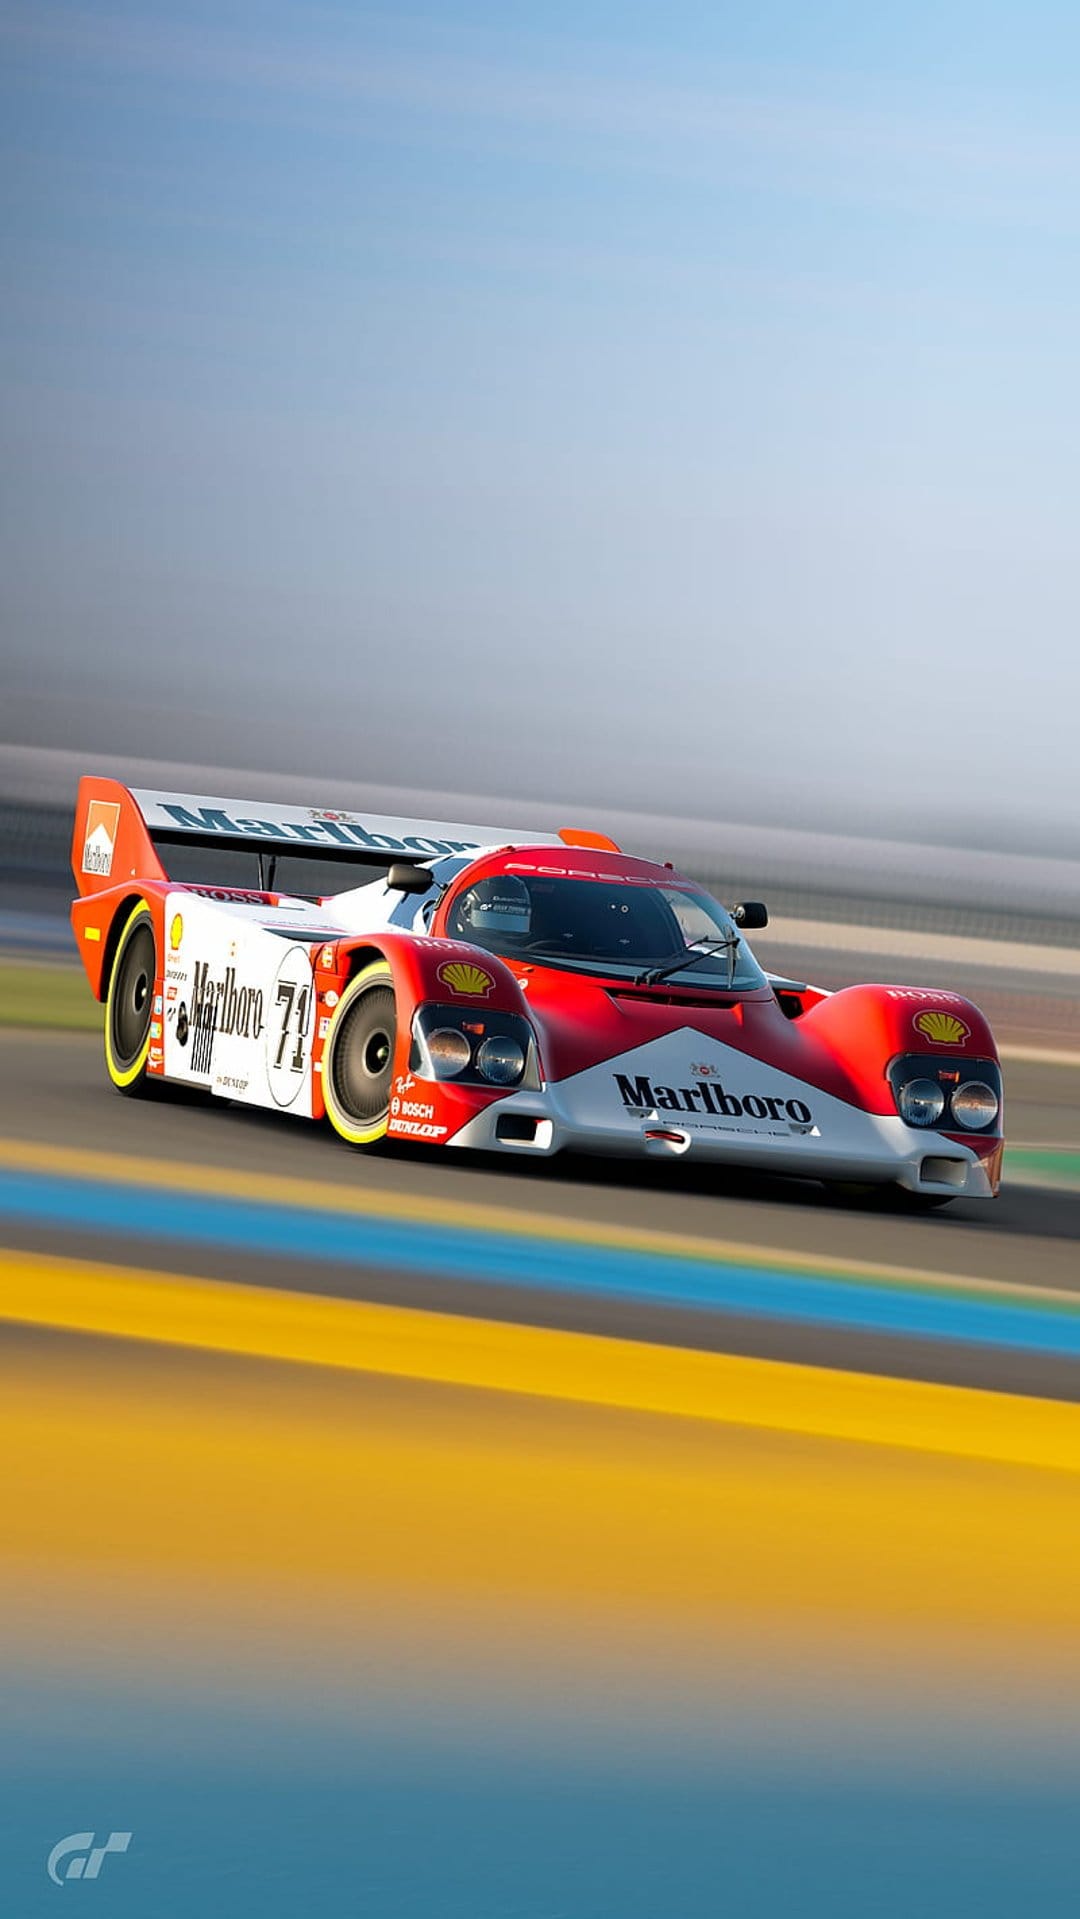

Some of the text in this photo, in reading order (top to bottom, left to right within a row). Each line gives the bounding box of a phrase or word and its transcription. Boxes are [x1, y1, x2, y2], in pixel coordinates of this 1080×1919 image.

[188, 960, 264, 1040] Marlboro
[274, 978, 312, 1074] 71
[401, 1101, 434, 1120] BOSCH
[612, 1073, 812, 1124] Marlboro
[388, 1118, 448, 1138] DUNLOP
